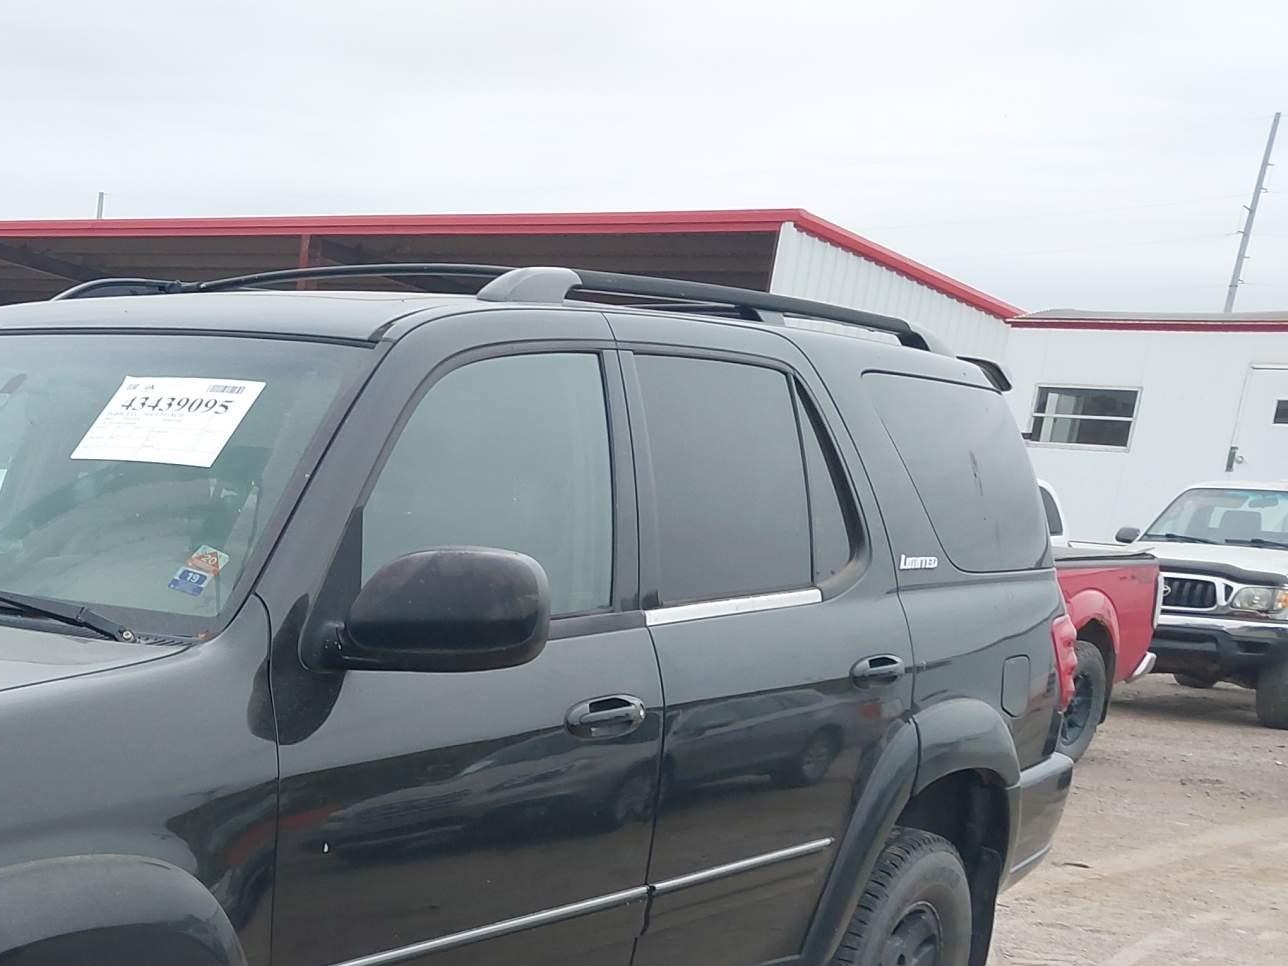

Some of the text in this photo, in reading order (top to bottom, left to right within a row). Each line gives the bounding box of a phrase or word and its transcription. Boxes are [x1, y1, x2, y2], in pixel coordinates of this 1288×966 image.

[121, 396, 235, 415] 43439095
[201, 552, 218, 566] 20
[186, 572, 200, 583] 19
